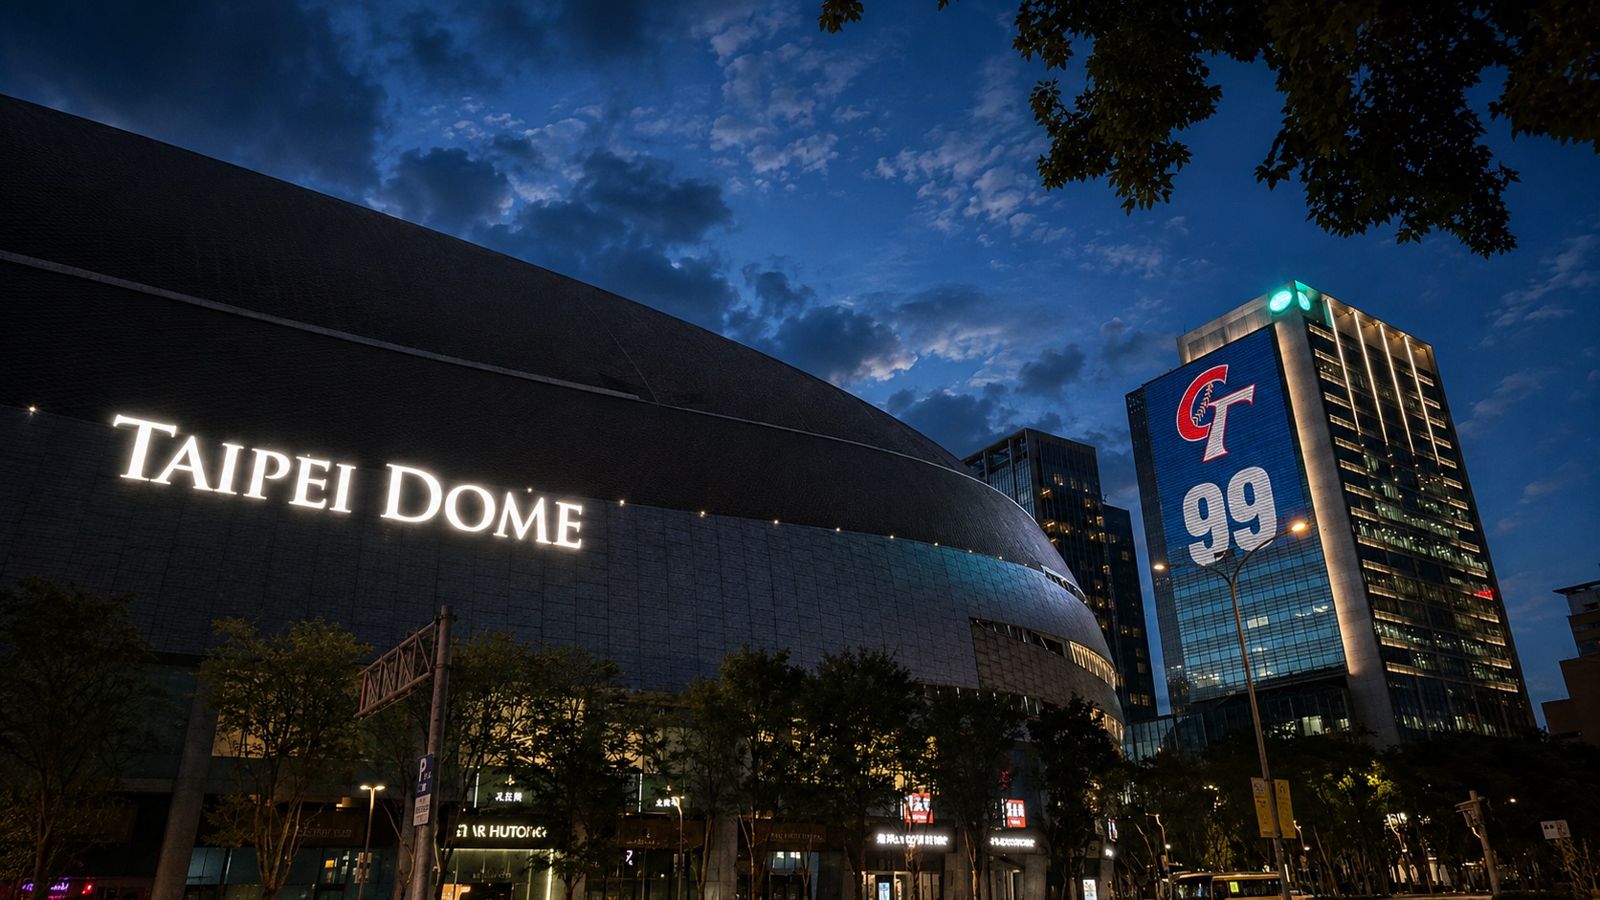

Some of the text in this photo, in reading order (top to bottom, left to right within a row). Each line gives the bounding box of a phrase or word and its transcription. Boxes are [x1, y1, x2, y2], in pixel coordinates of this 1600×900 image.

[113, 414, 583, 550] TAIPEI DOME
[1183, 466, 1277, 567] 99
